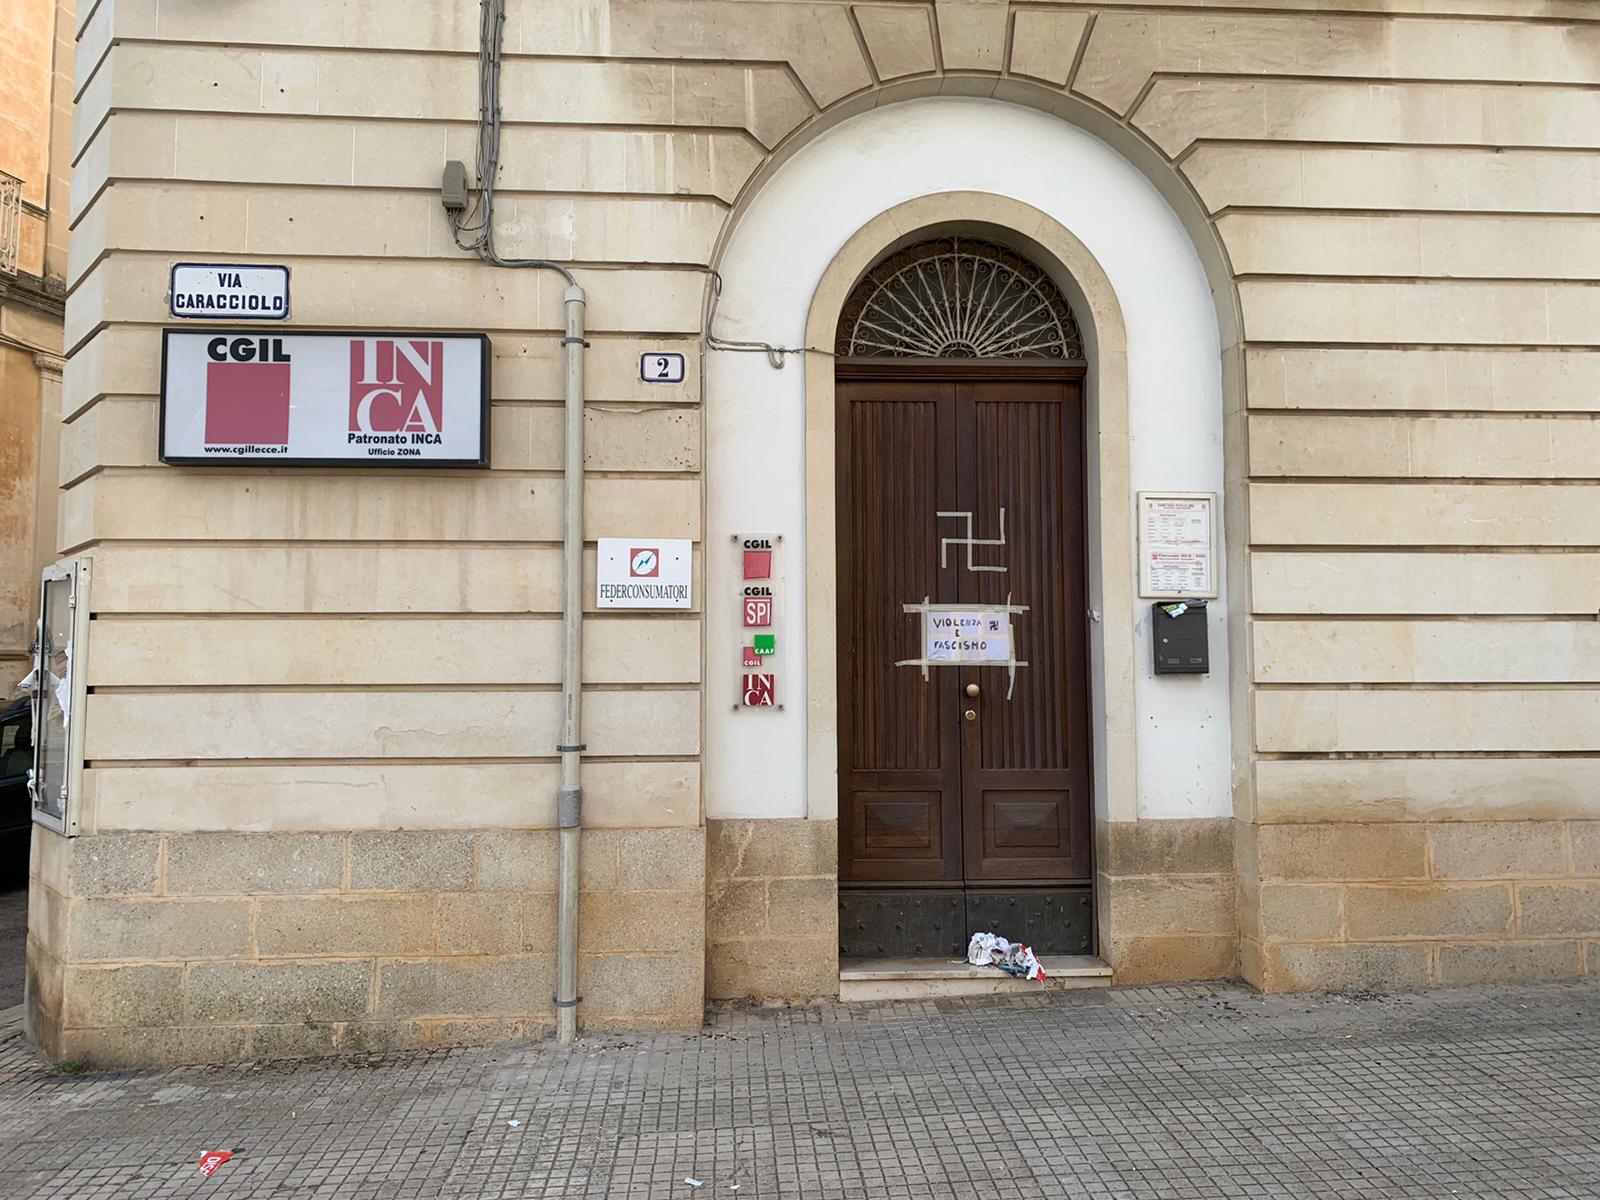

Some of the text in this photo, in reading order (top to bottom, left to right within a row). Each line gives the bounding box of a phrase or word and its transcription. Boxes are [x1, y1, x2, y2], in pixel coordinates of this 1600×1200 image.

[218, 273, 242, 288] VIA
[176, 293, 283, 311] CARACCIOLO
[207, 337, 291, 362] CGIL
[657, 357, 670, 378] 2
[347, 433, 442, 445] Patronato INCA
[204, 445, 288, 455] www.cgillecce.it
[368, 448, 421, 456] Ufficio ZONA
[743, 539, 772, 549] CGIL
[600, 584, 688, 599] FEDERCONSUMATORI
[744, 586, 773, 596] CGIL
[746, 602, 771, 625] SPI
[933, 618, 982, 628] VIOLENZA
[934, 641, 987, 650] FASCISMO
